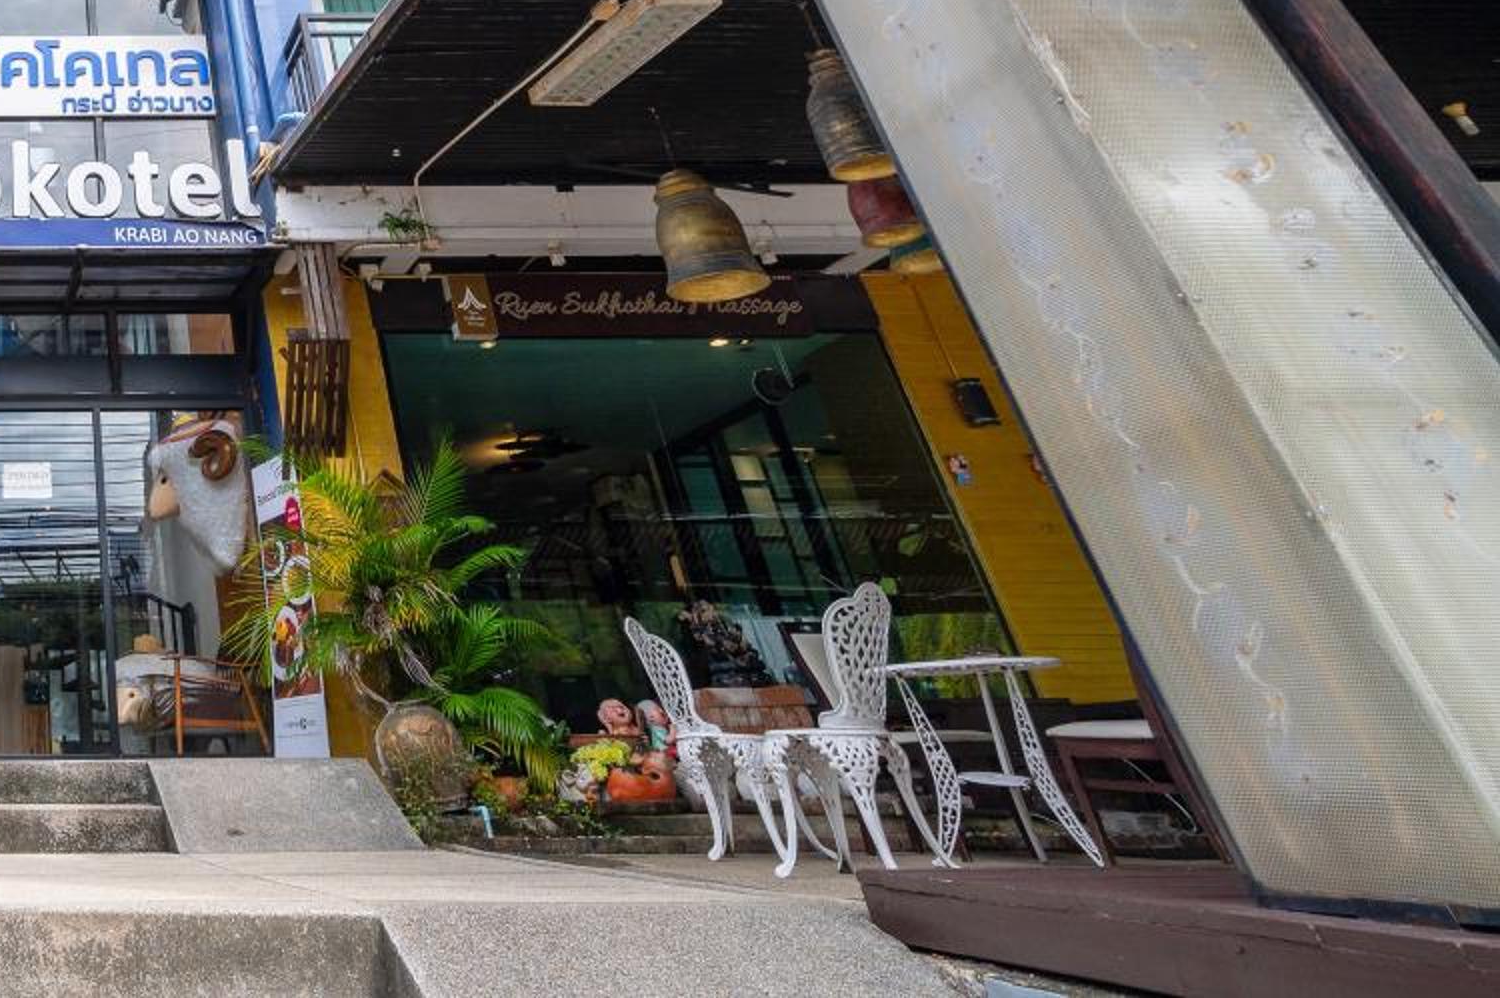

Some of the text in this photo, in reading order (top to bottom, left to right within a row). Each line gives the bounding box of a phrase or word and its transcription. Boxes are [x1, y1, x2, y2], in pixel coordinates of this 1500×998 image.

[115, 227, 258, 244] KRABI AO NANG
